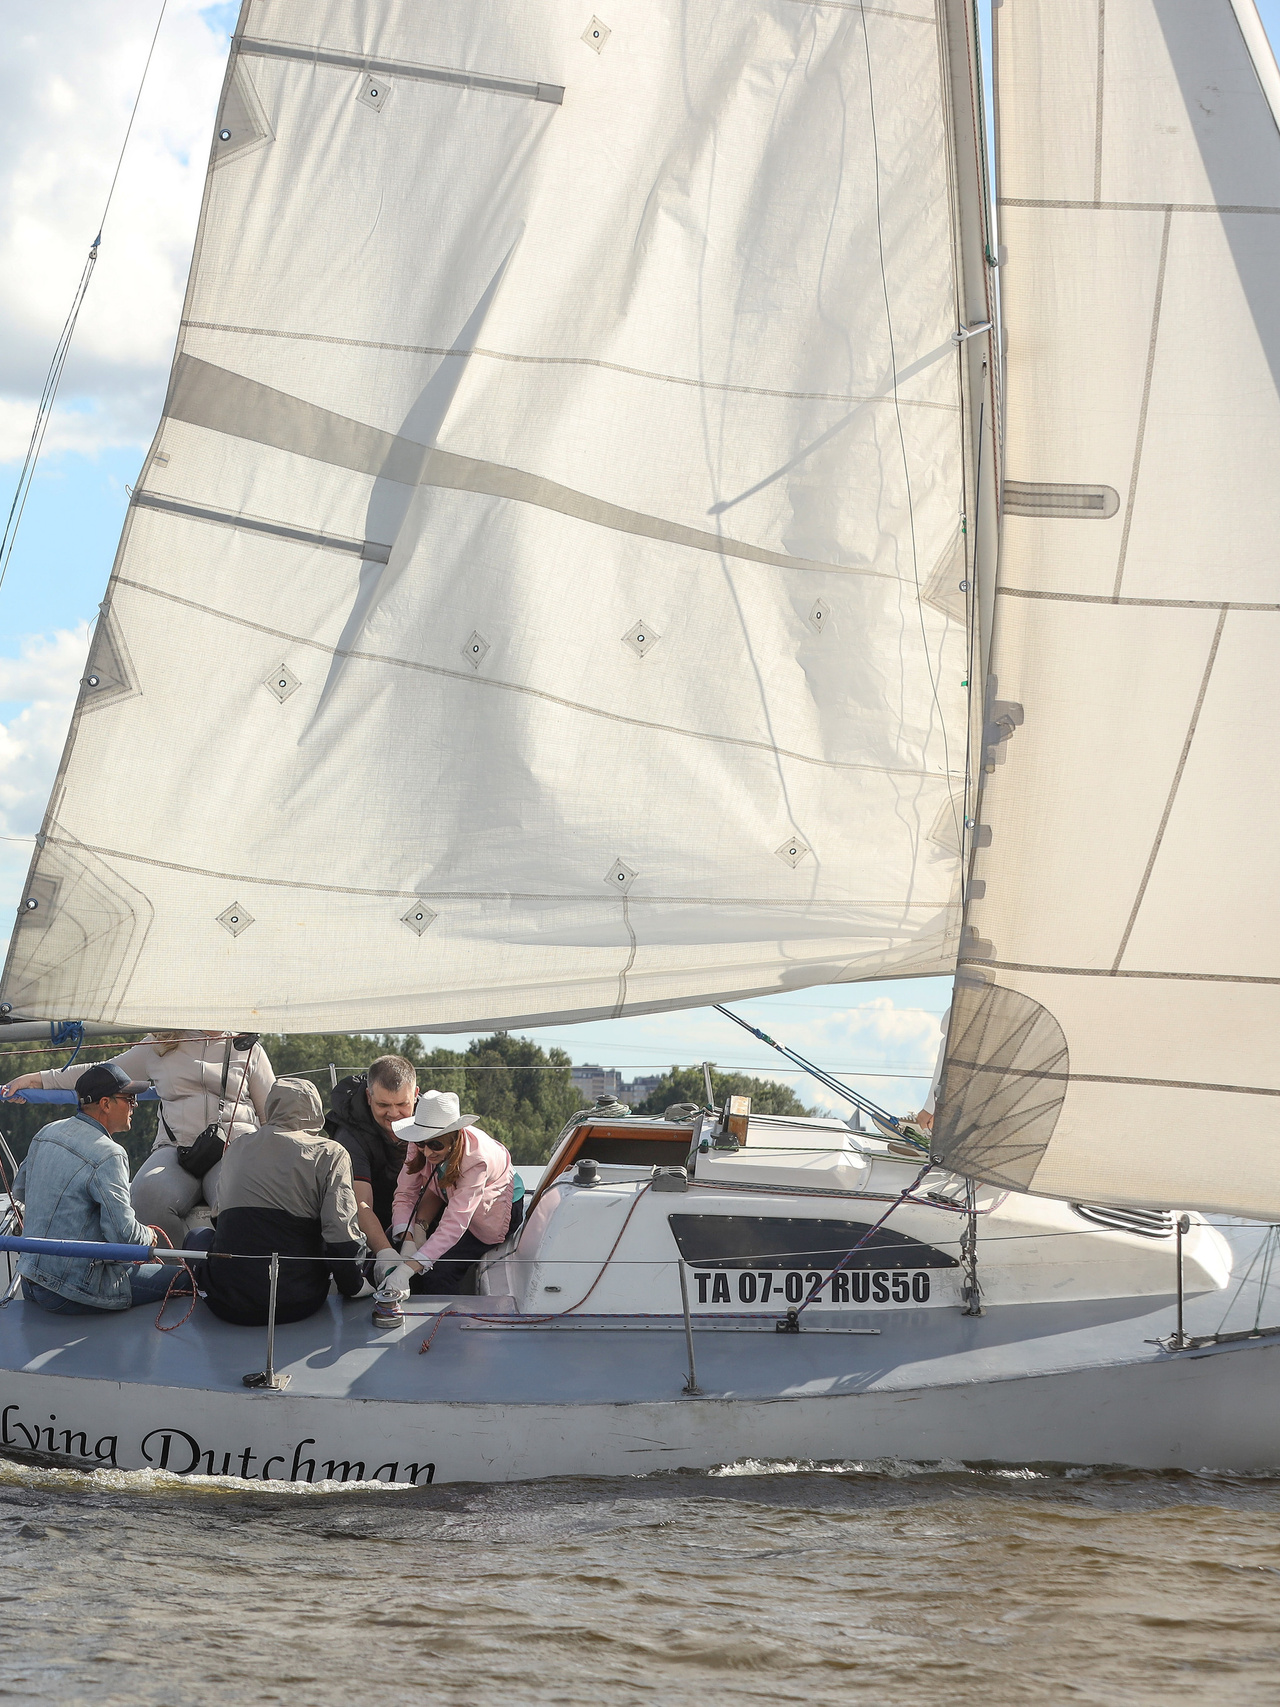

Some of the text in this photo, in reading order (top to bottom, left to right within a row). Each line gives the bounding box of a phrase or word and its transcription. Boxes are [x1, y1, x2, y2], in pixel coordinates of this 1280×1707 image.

[694, 1271, 930, 1304] TA 07-02 RUS50
[140, 1428, 436, 1485] Dutchman
